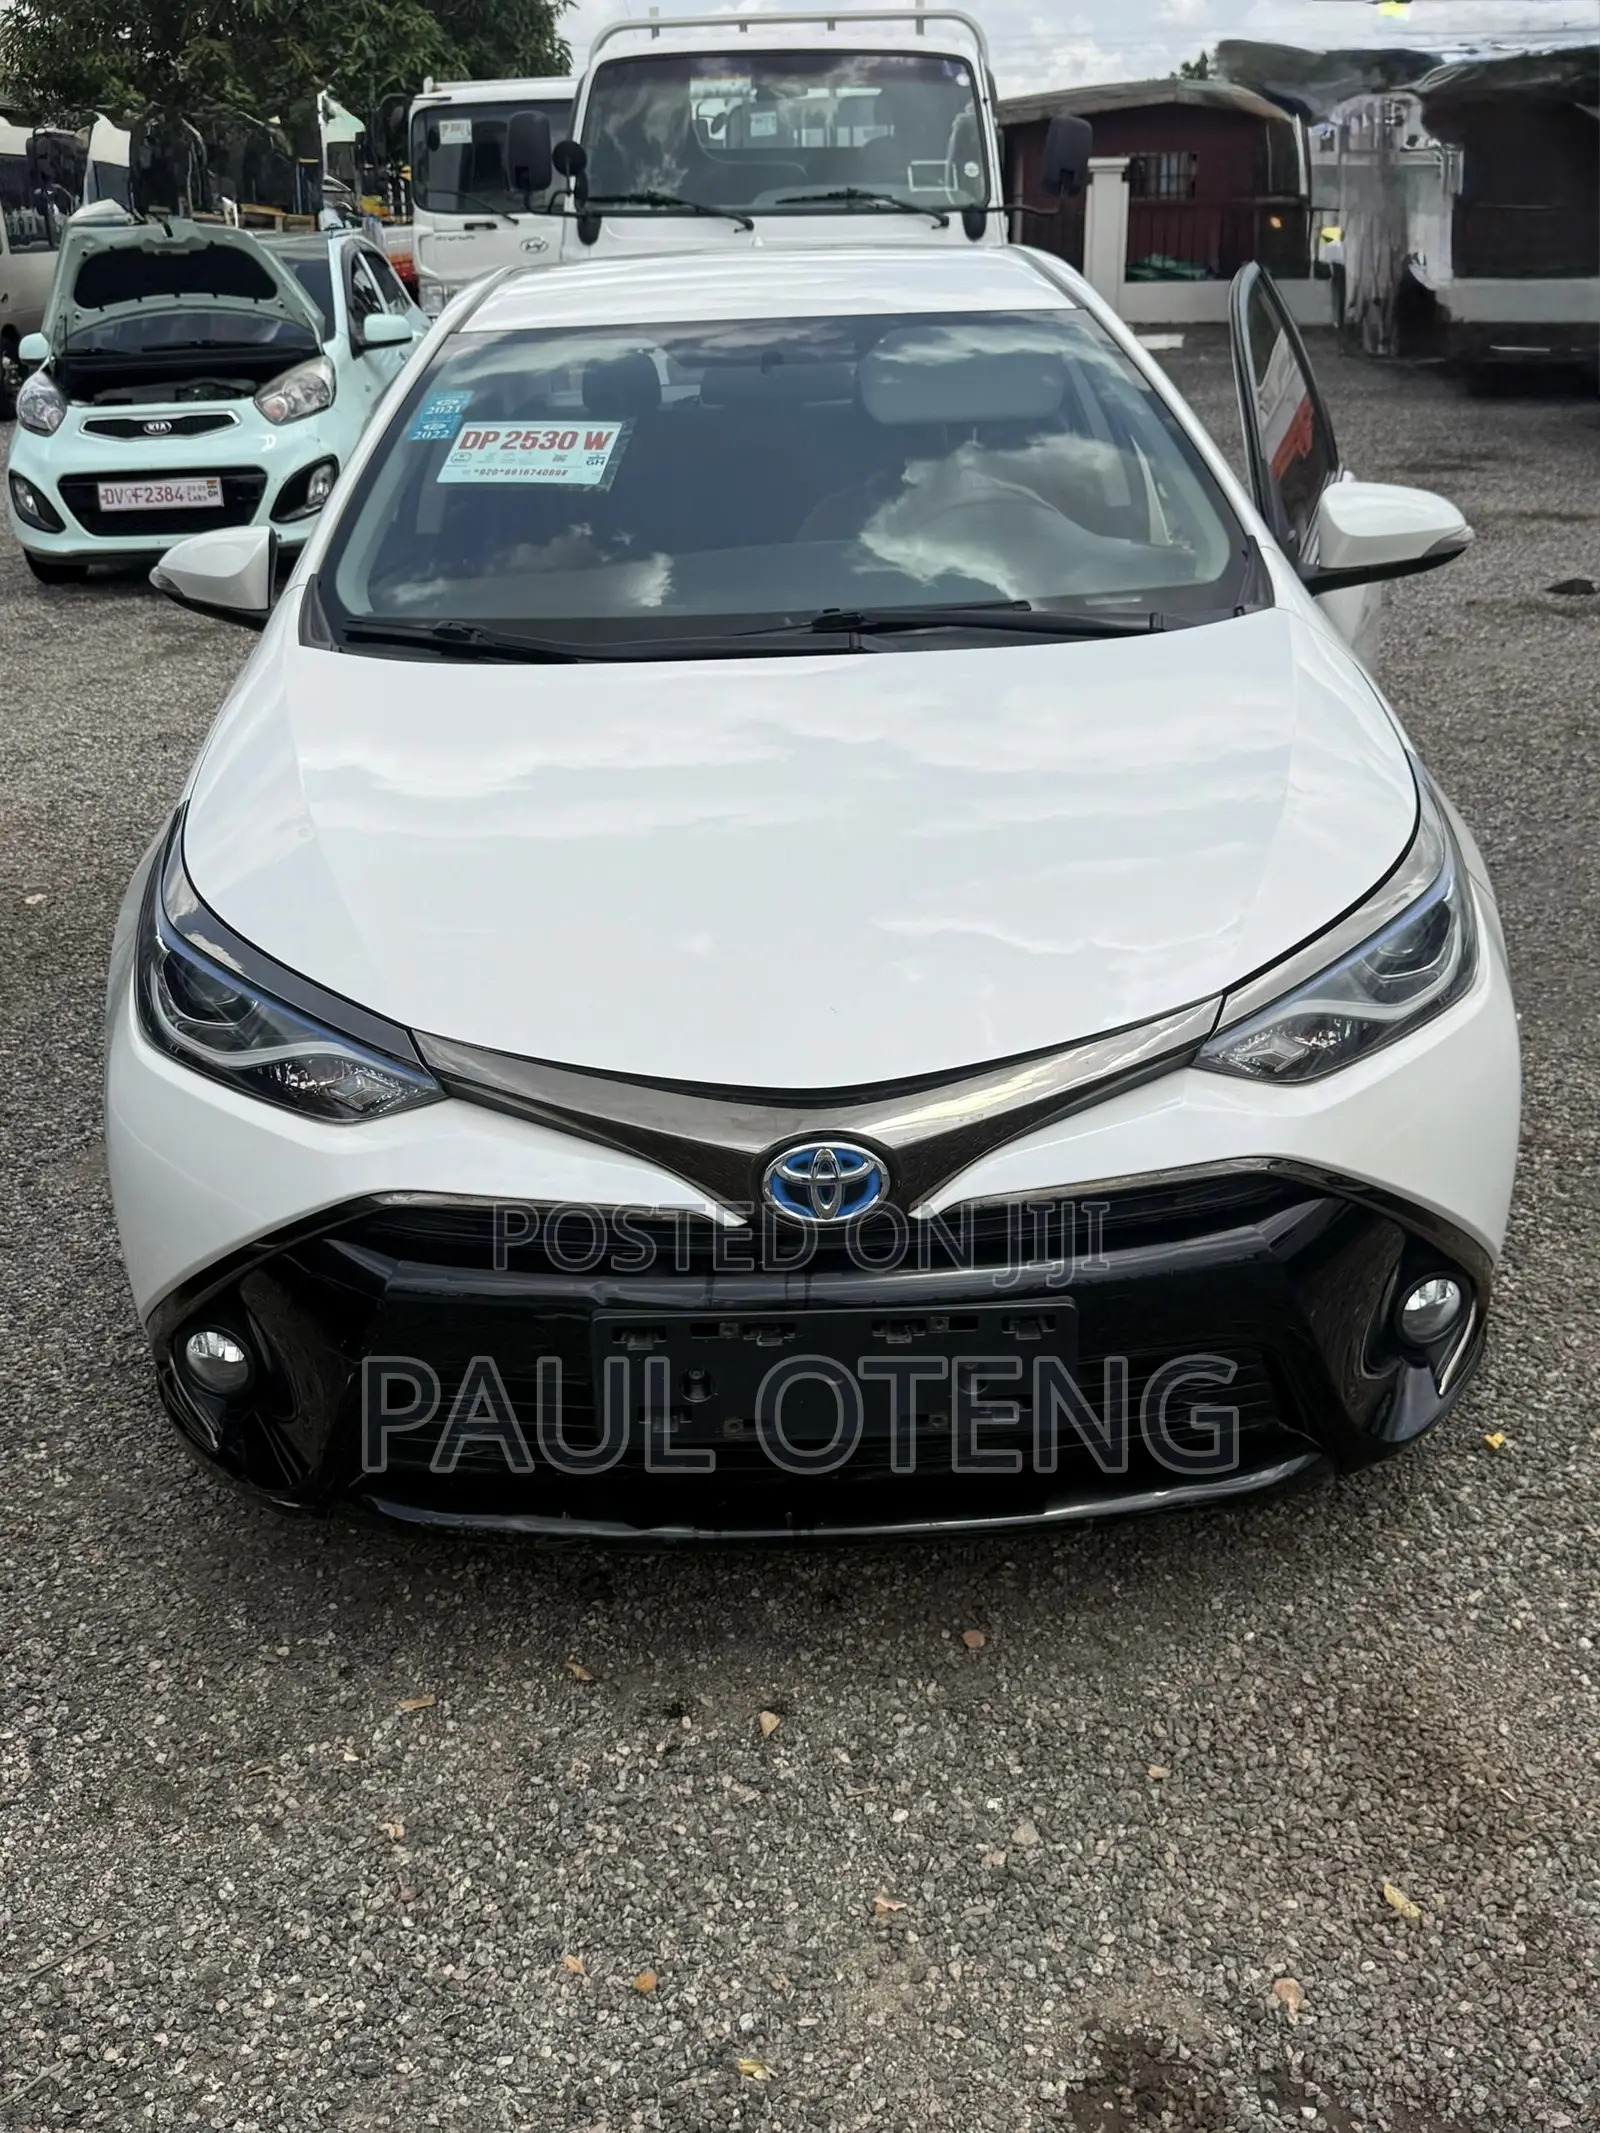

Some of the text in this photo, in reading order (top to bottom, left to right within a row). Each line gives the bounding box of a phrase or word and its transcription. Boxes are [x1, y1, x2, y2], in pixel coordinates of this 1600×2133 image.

[425, 404, 461, 415] 2021
[412, 430, 450, 440] 2022
[458, 431, 614, 451] DP 2530 W
